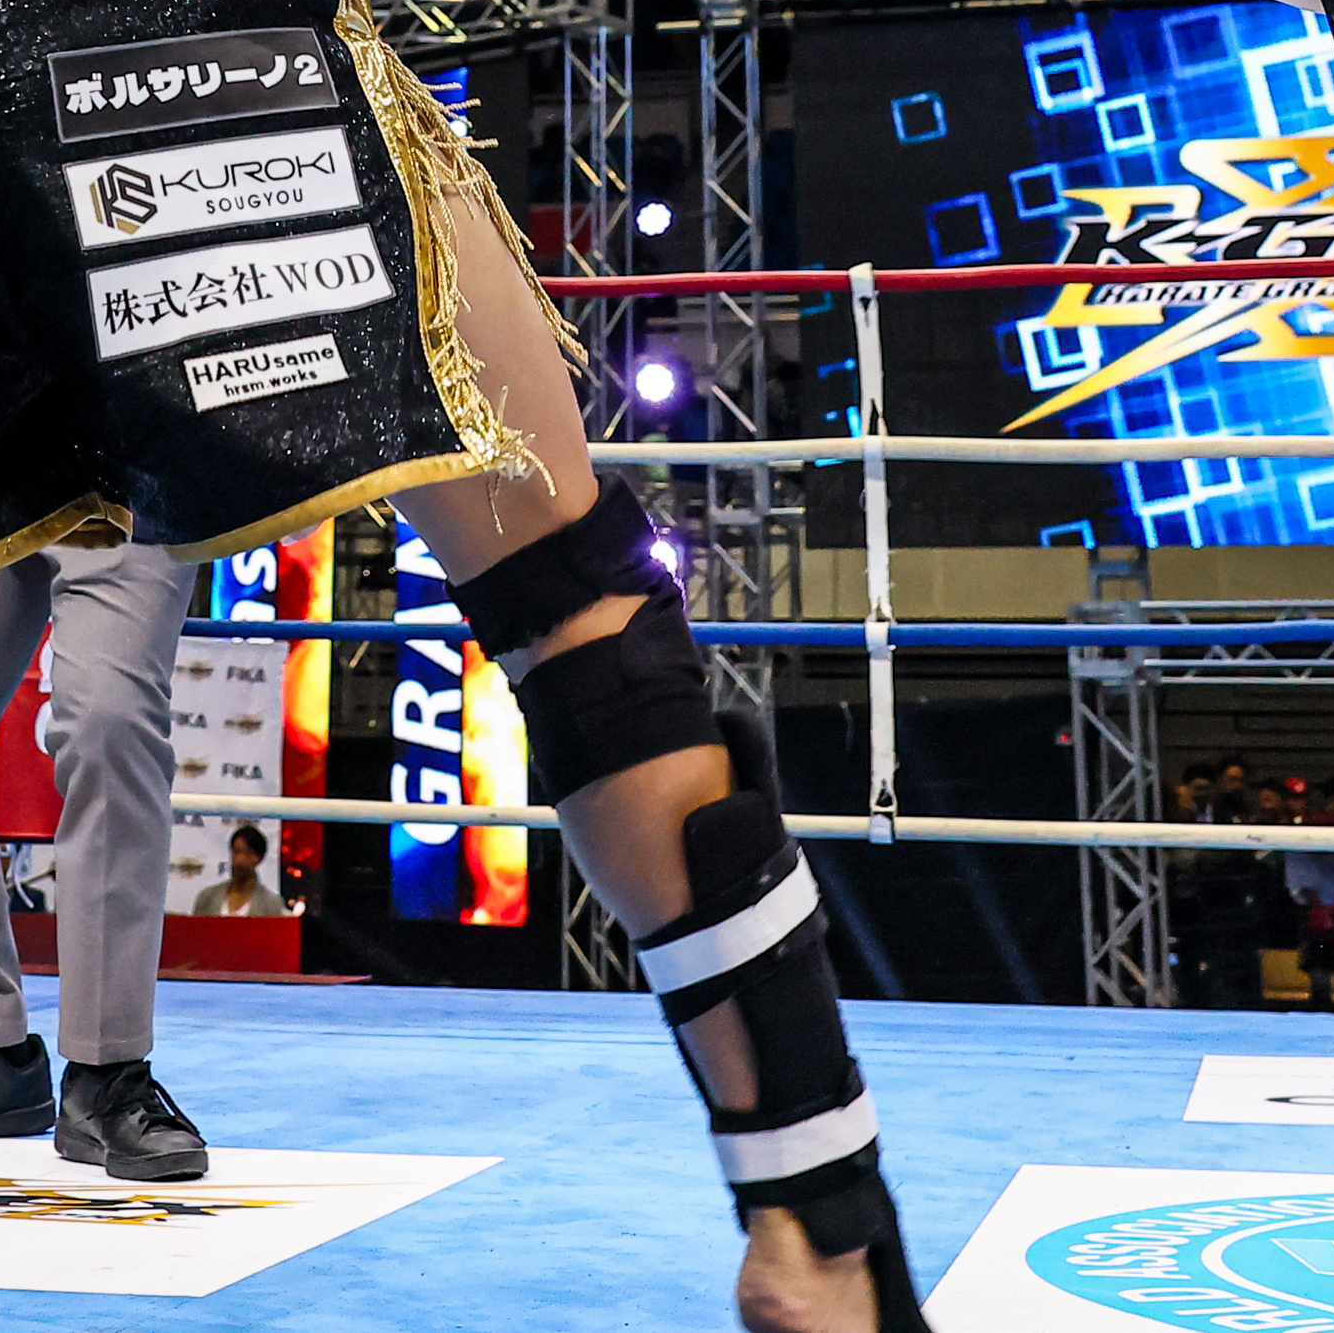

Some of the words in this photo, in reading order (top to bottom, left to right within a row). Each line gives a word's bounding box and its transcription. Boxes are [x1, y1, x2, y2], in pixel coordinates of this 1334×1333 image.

[65, 53, 325, 115] ボルサリーノ2
[159, 151, 337, 197] KUROKI
[205, 187, 305, 215] SOUGYOU
[191, 346, 335, 387] HARUsame
